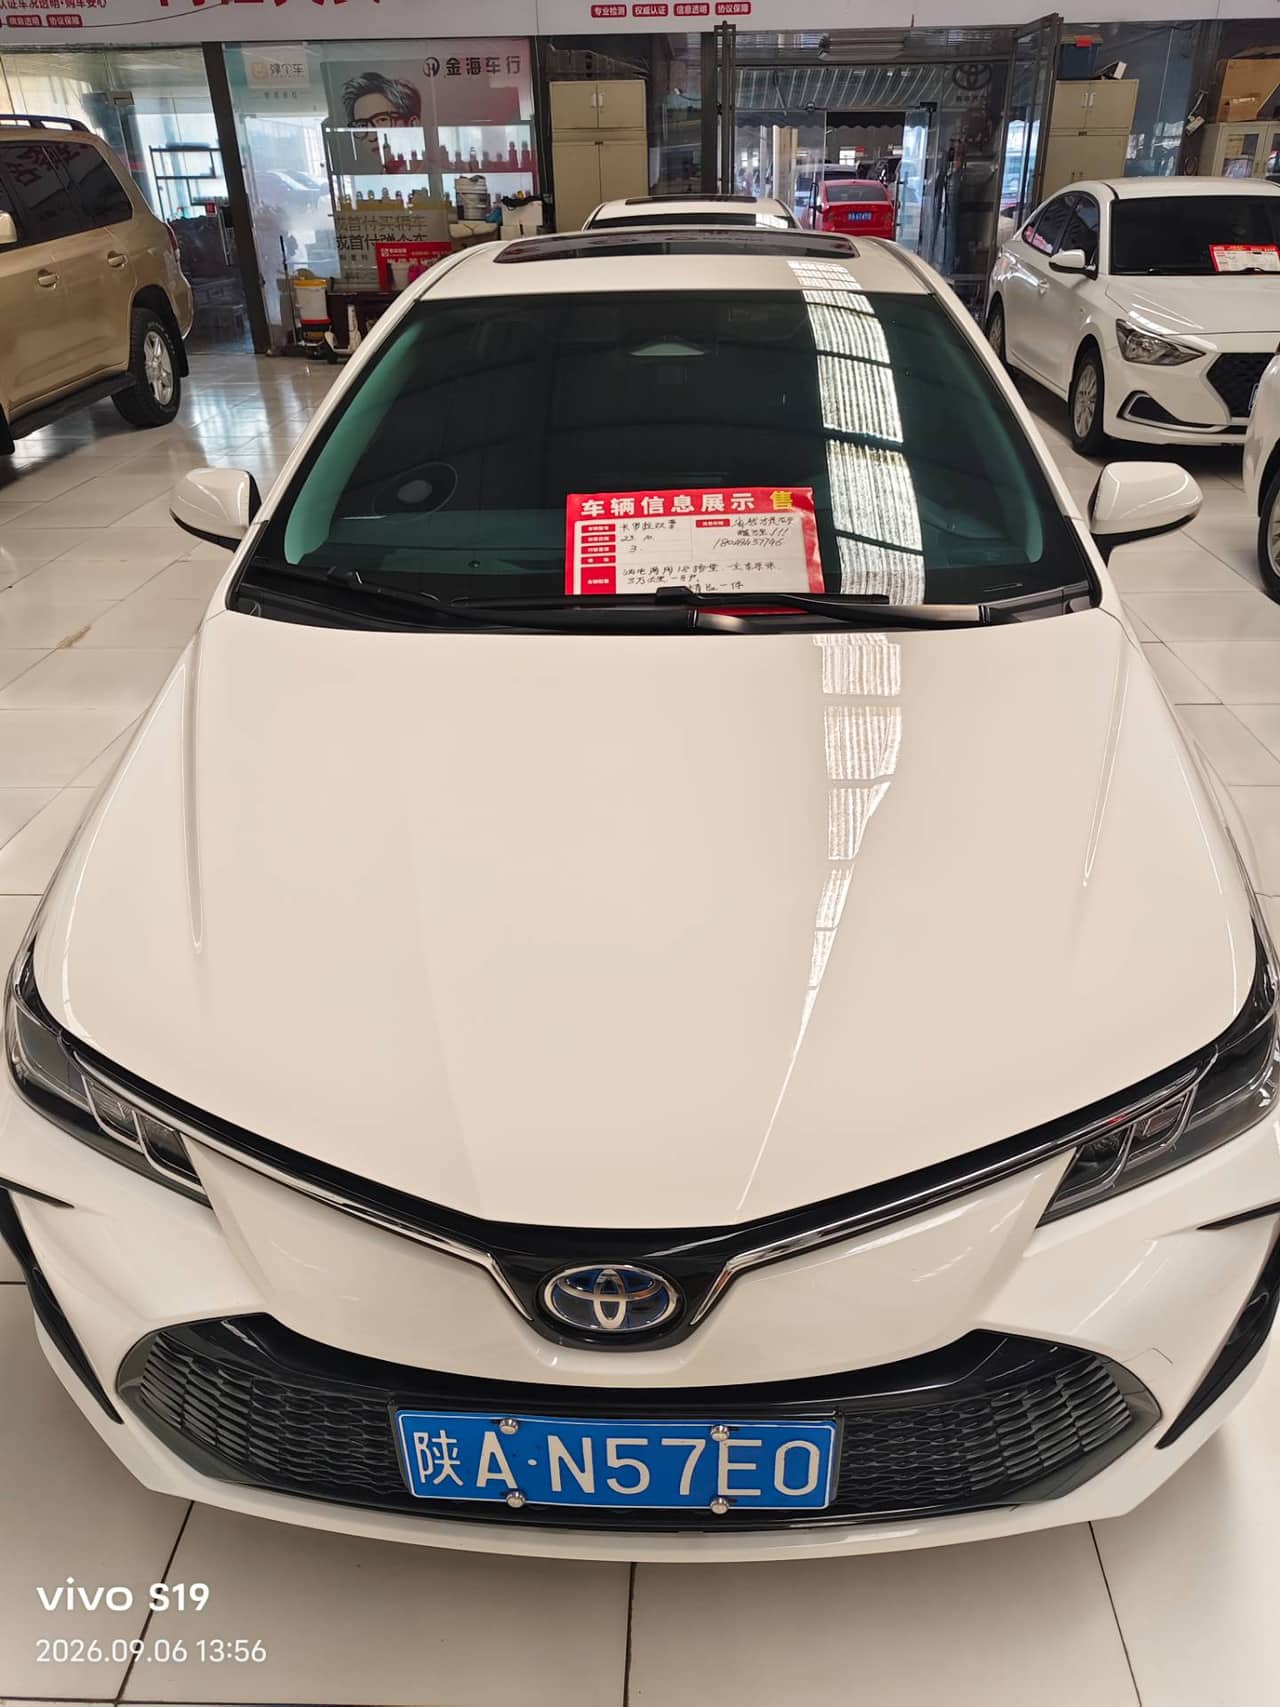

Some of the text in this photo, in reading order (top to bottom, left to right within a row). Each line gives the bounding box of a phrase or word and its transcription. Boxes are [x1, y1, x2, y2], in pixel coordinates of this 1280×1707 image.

[634, 6, 666, 16] 权威认证
[676, 5, 708, 15] 信息透明
[717, 4, 750, 14] 协议保障
[445, 55, 521, 76] 金海车行
[580, 490, 794, 517] 车辆信息展示 售
